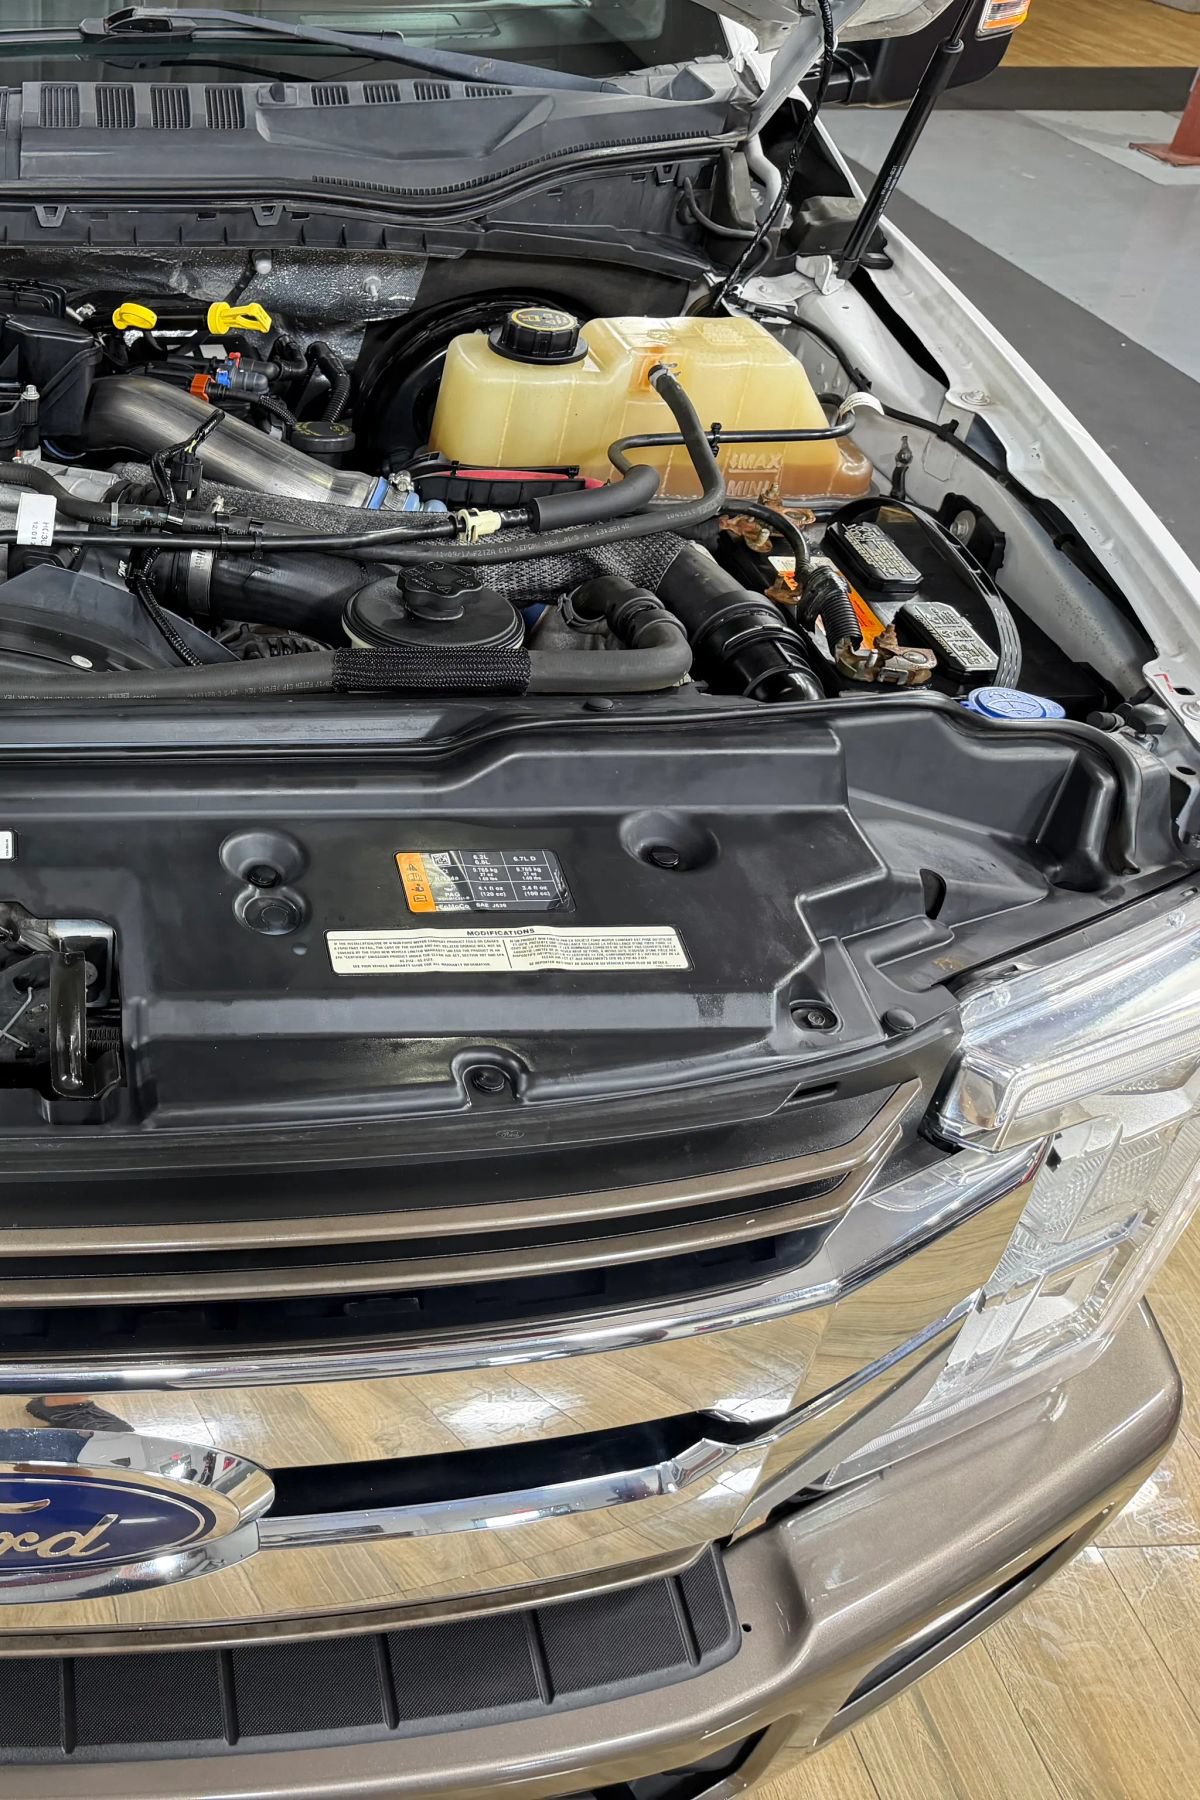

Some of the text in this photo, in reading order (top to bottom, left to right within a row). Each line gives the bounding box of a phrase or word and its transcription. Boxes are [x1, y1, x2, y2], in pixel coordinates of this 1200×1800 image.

[738, 453, 781, 470] MAX
[726, 480, 764, 498] MIN
[467, 928, 535, 936] MODIFICATIONS
